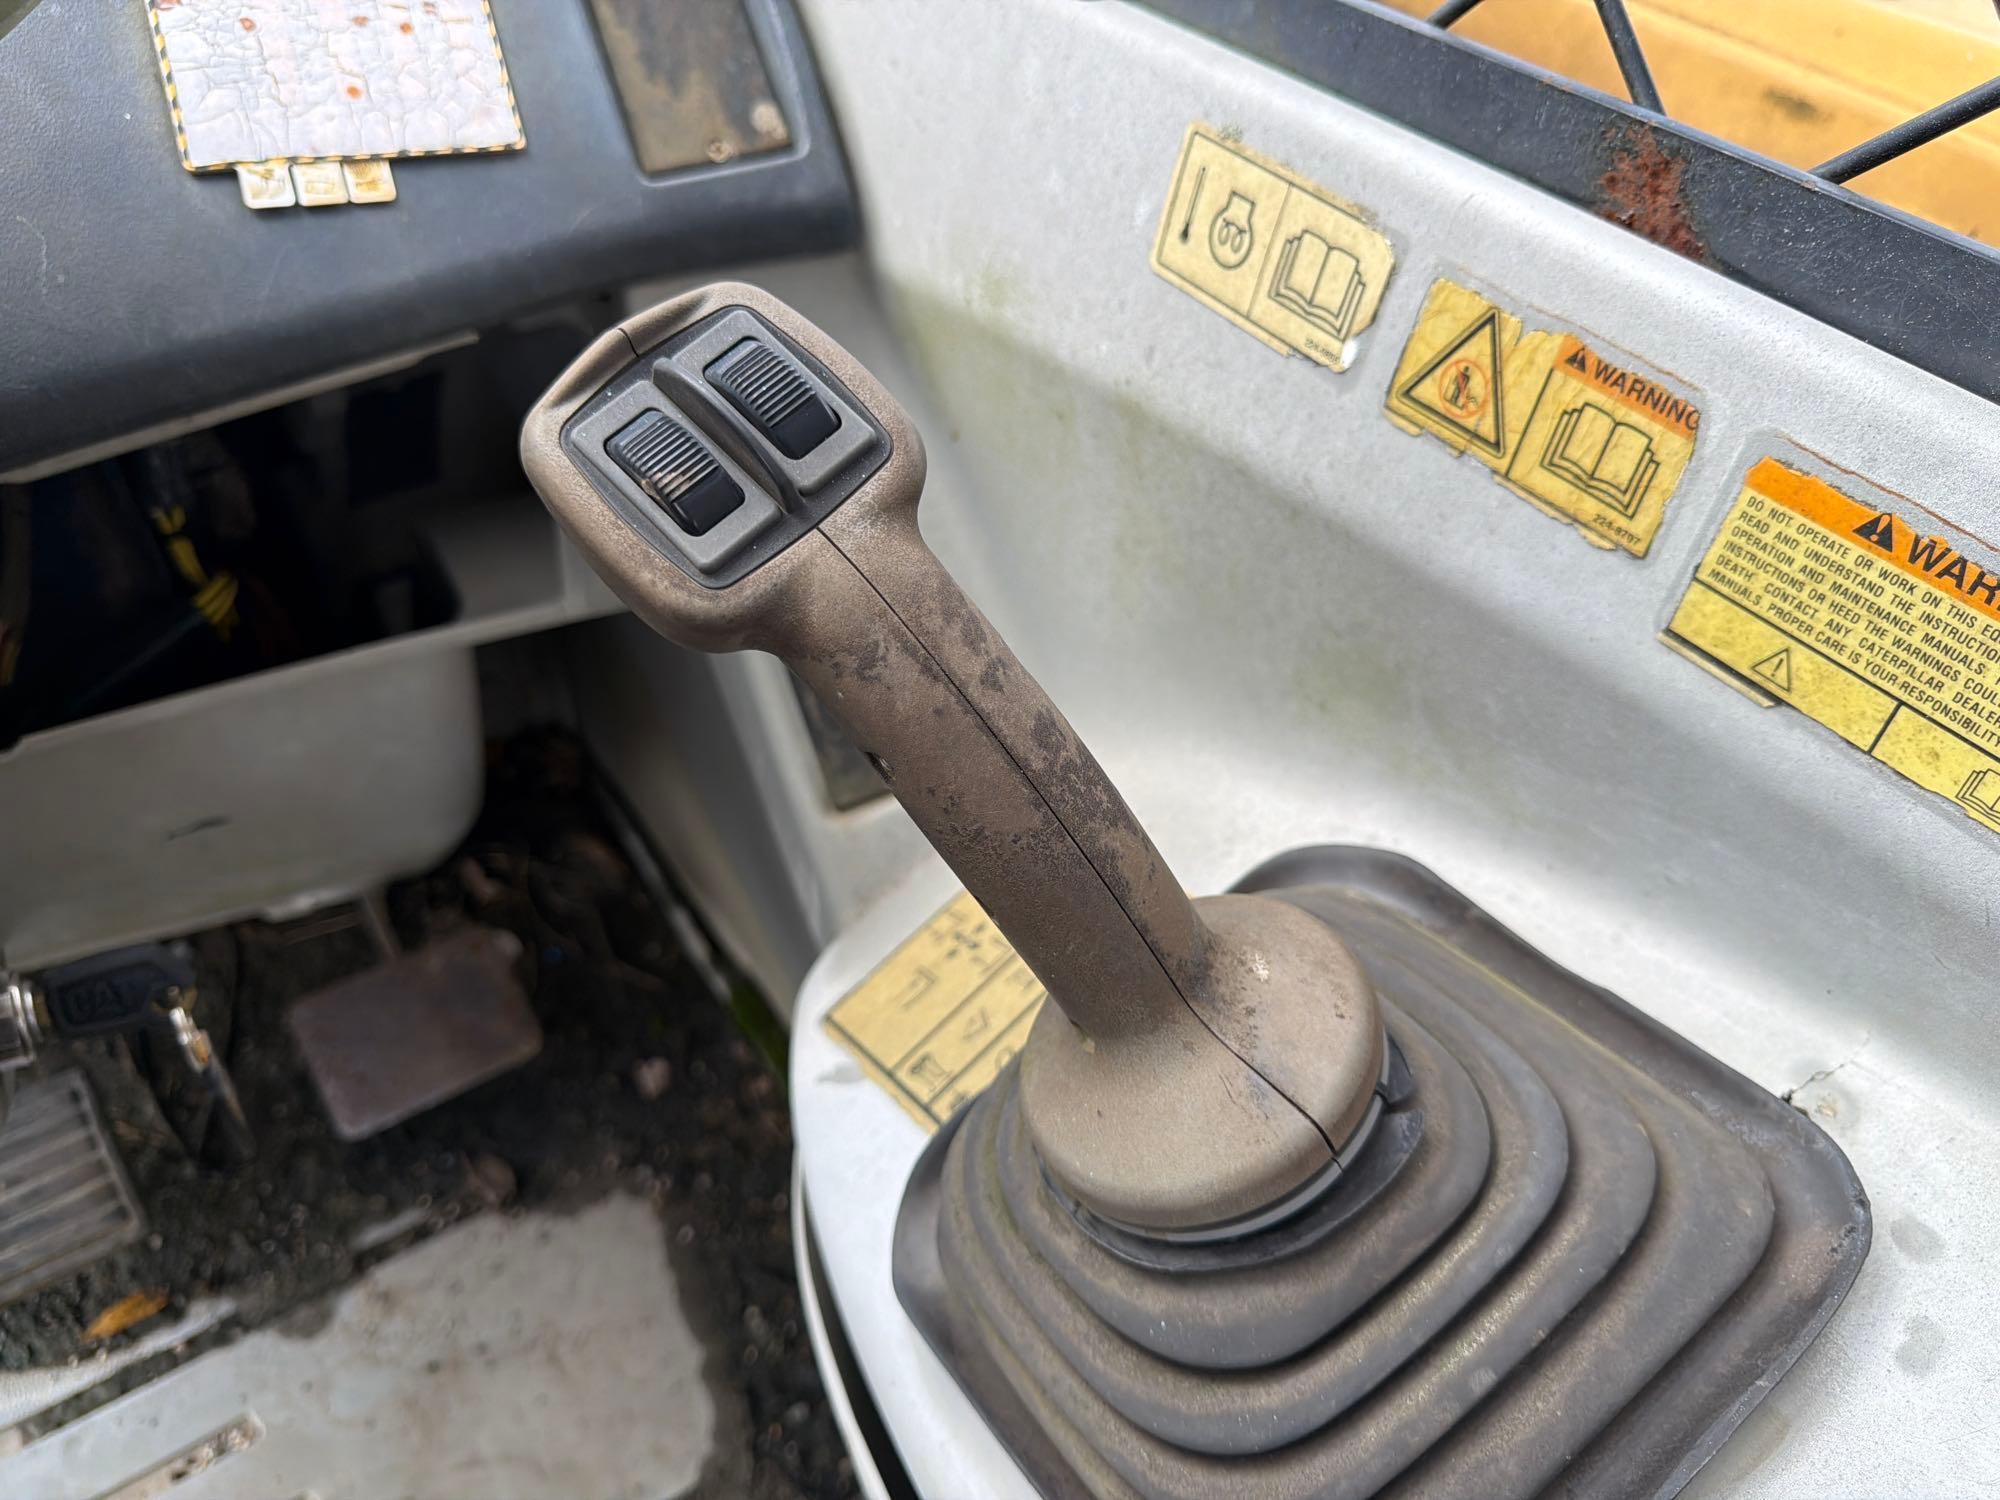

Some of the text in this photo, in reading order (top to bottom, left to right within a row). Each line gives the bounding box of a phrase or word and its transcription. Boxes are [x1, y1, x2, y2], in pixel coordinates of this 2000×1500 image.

[1593, 358, 1701, 431] WARNING
[1731, 525, 1987, 679] OPERATION AND MAINTENANCE MANUALS.
[1738, 510, 1770, 535] READ
[1772, 531, 1800, 551] AND
[1803, 546, 1885, 598] UNDERSTAND
[1889, 593, 1917, 616] THE
[1746, 496, 2000, 646] DO NOT OPERATE OR WORK ON THIS EQ
[1907, 532, 2000, 612] WAR
[1722, 540, 2000, 709] INSTRUCTIONS OR HEED THE WARNINGS COUL
[1763, 582, 1820, 621] CONTACT
[1823, 618, 1855, 639] ANY
[1858, 636, 1946, 694] CATERPILLAR
[1766, 602, 1815, 637] PROPER
[1814, 631, 1848, 656] CARE
[1847, 650, 1862, 665] IS
[1863, 659, 1900, 687] YOUR
